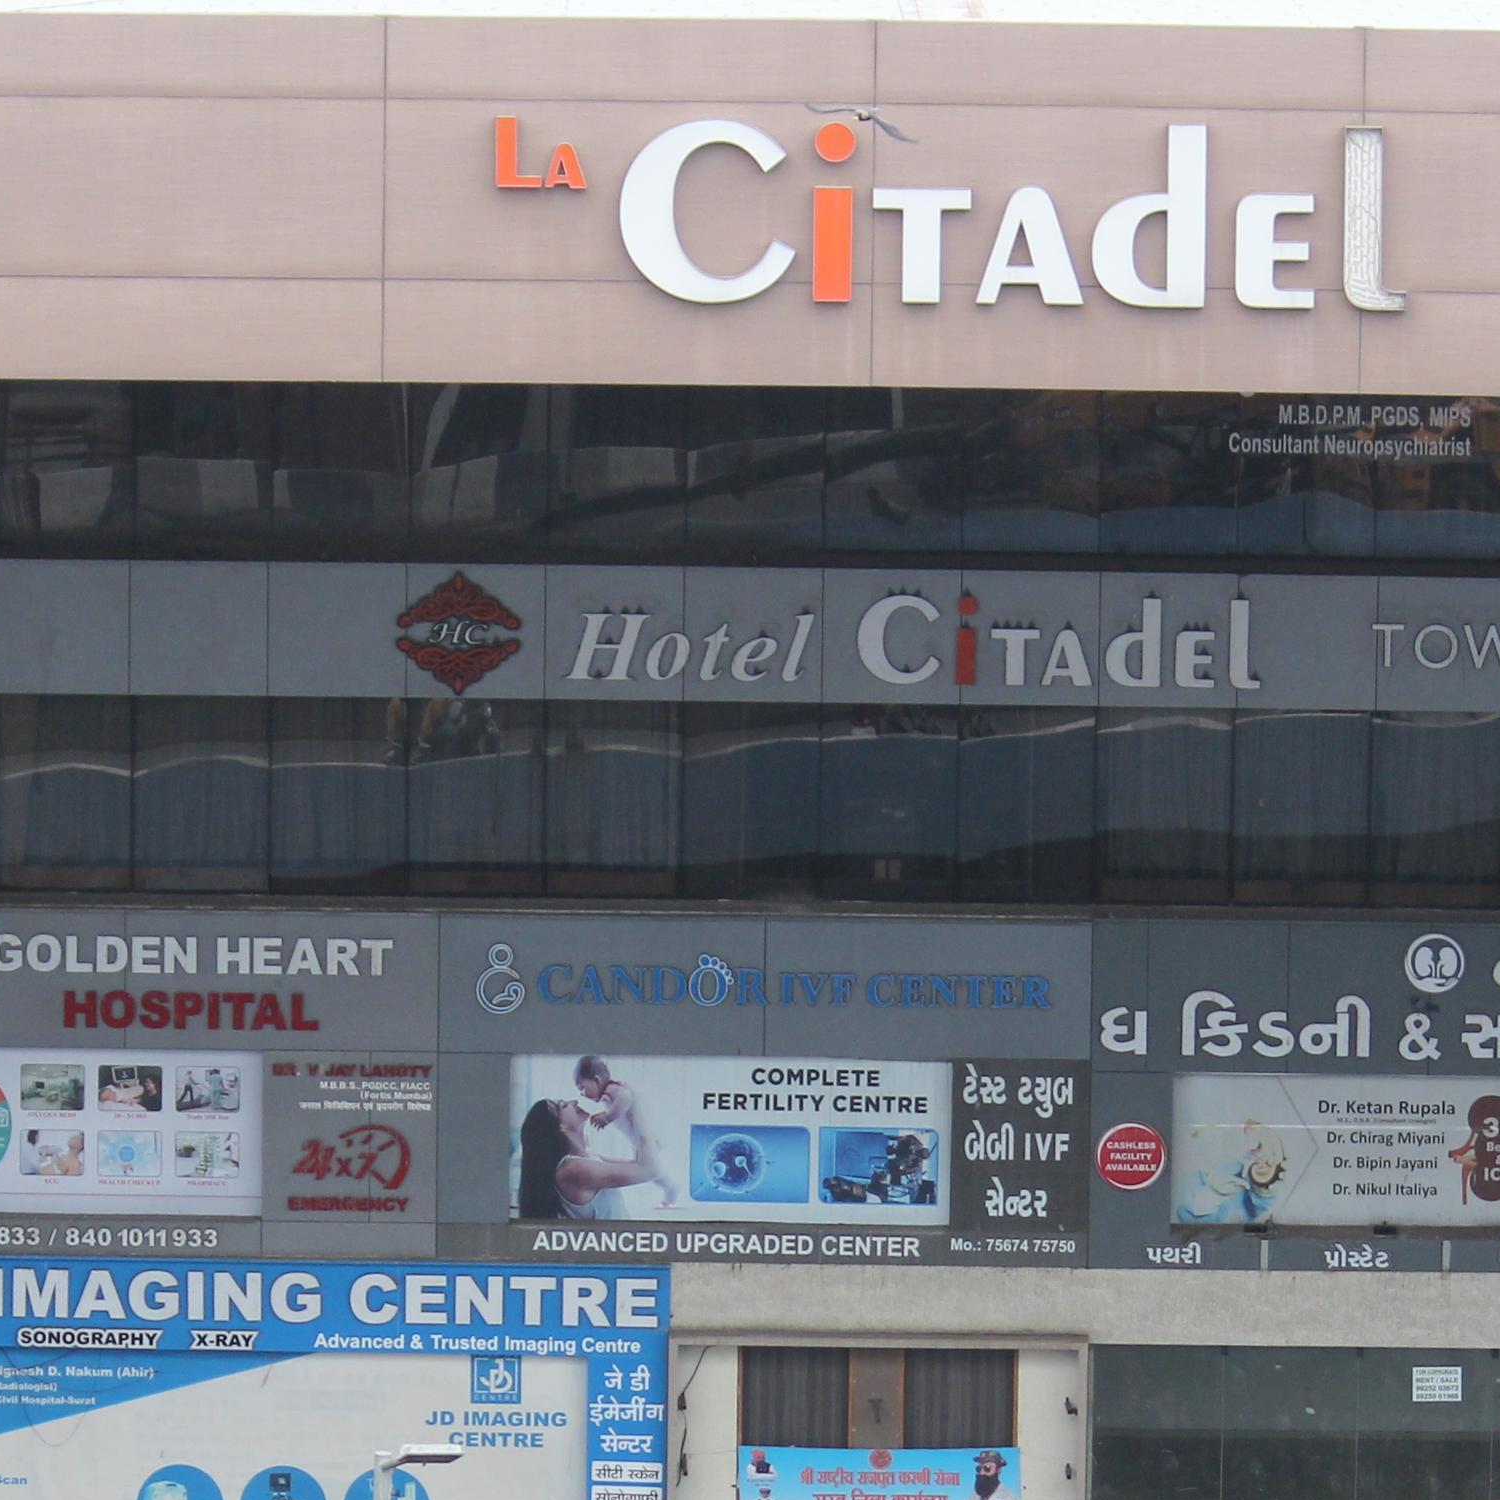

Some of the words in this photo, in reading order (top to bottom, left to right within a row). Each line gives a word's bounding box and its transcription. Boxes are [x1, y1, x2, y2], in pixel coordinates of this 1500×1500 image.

[1228, 432, 1320, 456] Consultant
[1323, 433, 1472, 460] Neuropsychiatrist
[564, 611, 813, 685] Hotel
[215, 937, 394, 977] HEART
[537, 953, 768, 1008] CANDOR
[781, 972, 853, 1008] IVF
[865, 973, 1052, 1010] CENTER
[61, 989, 320, 1032] HOSPITAL
[1099, 1007, 1148, 1058] ધ
[1180, 990, 1371, 1060] કિડની
[1396, 1013, 1442, 1062] &
[750, 1067, 881, 1089] COMPLETE
[962, 1062, 1007, 1107] ટેસ્ટ
[701, 1092, 823, 1113] FERTILITY
[832, 1094, 928, 1115] CENTRE
[1317, 1100, 1341, 1115] Dr.
[1345, 1100, 1394, 1115] Ketan
[1398, 1101, 1456, 1118] Rupala
[963, 1119, 1015, 1162] બેબી
[1024, 1132, 1070, 1161] IVF
[1326, 1131, 1347, 1144] Dr.
[1349, 1131, 1394, 1147] Chirag
[1396, 1132, 1445, 1147] Miyani
[1332, 1156, 1353, 1169] Dr.
[1355, 1156, 1392, 1171] Bipin
[1395, 1156, 1438, 1172] Jayani
[286, 1195, 409, 1213] EMERGENCY
[984, 1177, 1049, 1218] સેન્ટર
[1332, 1183, 1353, 1196] Dr.
[1354, 1183, 1392, 1196] Nikul
[1395, 1183, 1438, 1199] Italiya
[532, 1231, 668, 1254] ADVANCED
[676, 1233, 814, 1256] UPGRADED
[820, 1235, 920, 1258] CENTER
[1145, 1240, 1203, 1268] પથરી
[328, 1273, 660, 1331] CENTRE
[20, 1329, 158, 1347] SONOGRAPHY
[194, 1332, 254, 1348] X-RAY
[313, 1333, 406, 1350] Advanced
[409, 1335, 424, 1349] &
[430, 1334, 499, 1351] Trusted
[504, 1335, 578, 1356] Imaging
[581, 1337, 642, 1354] Centre
[603, 1364, 623, 1392] जे
[627, 1364, 651, 1392] डी
[424, 1410, 455, 1427] JD
[462, 1411, 568, 1428] IMAGING
[448, 1431, 544, 1449] CENTRE
[600, 1428, 653, 1456] सेन्टर
[595, 1463, 624, 1481] सीटी
[627, 1465, 660, 1482] स्केन
